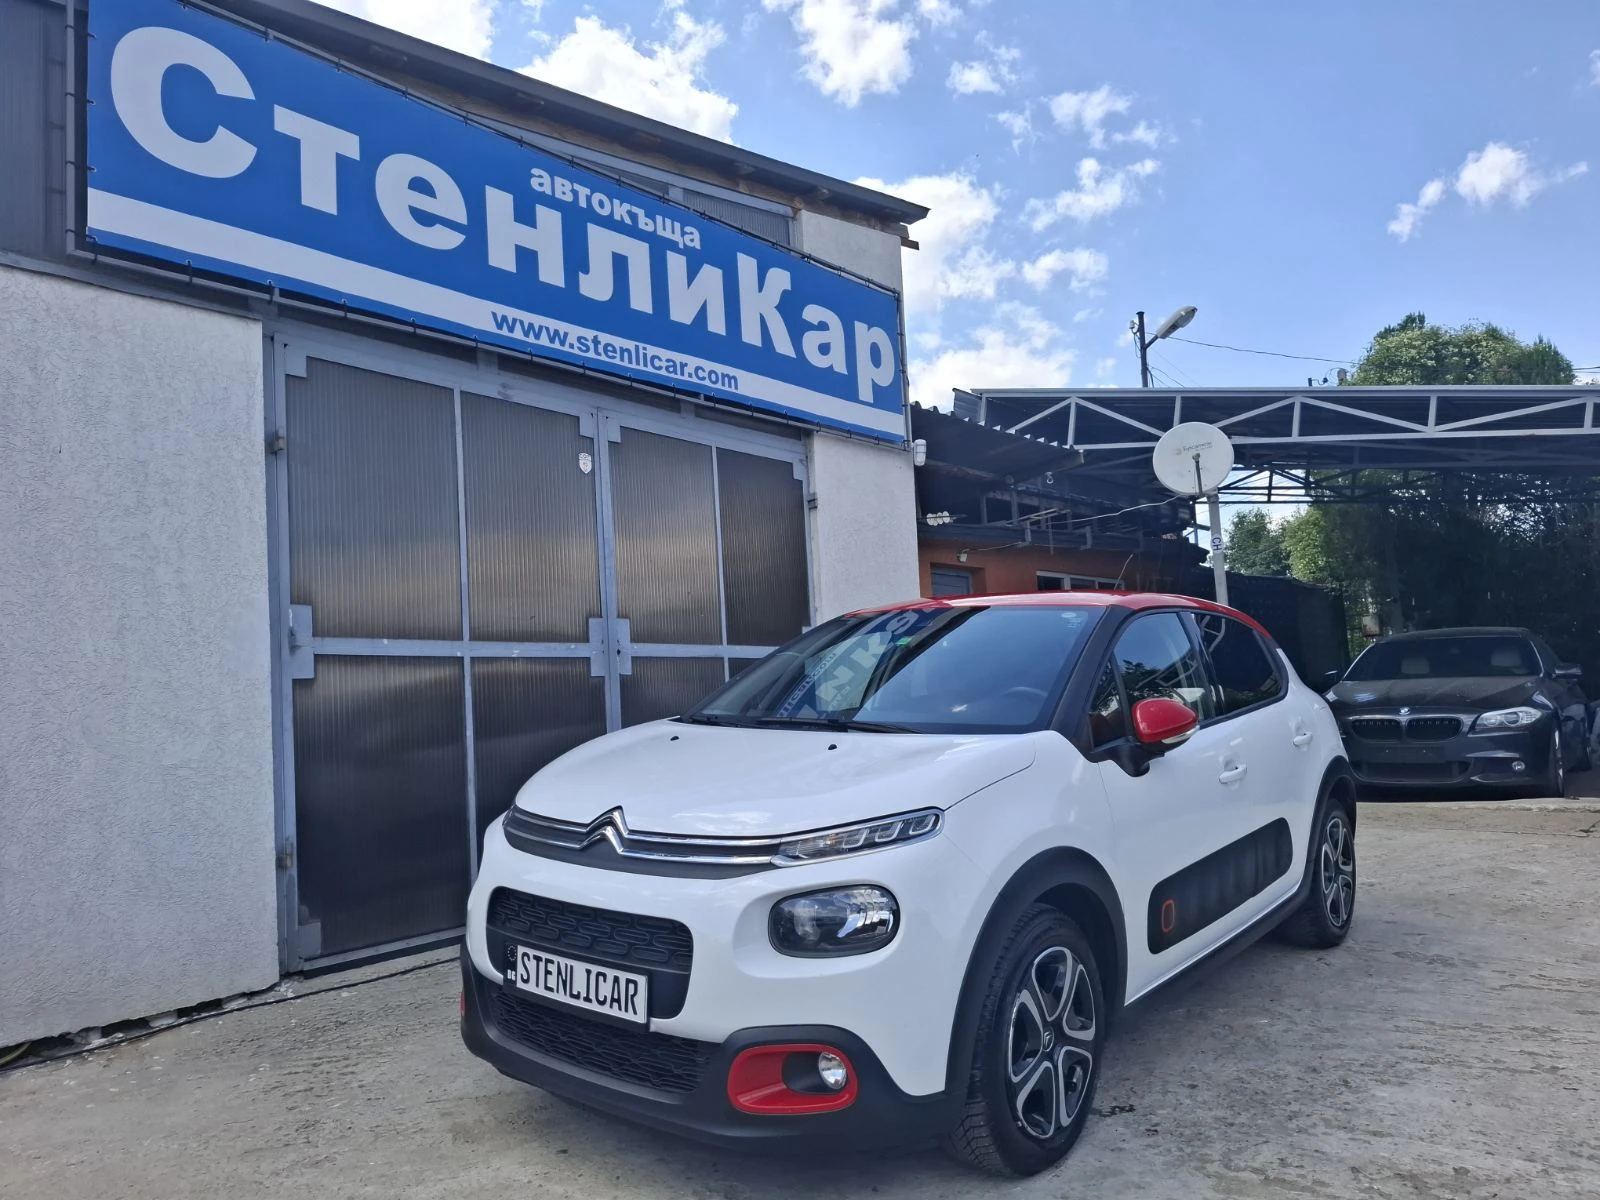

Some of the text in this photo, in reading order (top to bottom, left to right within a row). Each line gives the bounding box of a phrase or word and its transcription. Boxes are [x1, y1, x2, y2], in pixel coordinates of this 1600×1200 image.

[110, 26, 896, 404] СтенлиКар
[530, 167, 702, 250] автокъща
[490, 311, 740, 391] www.stenlicar.com
[520, 951, 639, 1016] STENLICAR
